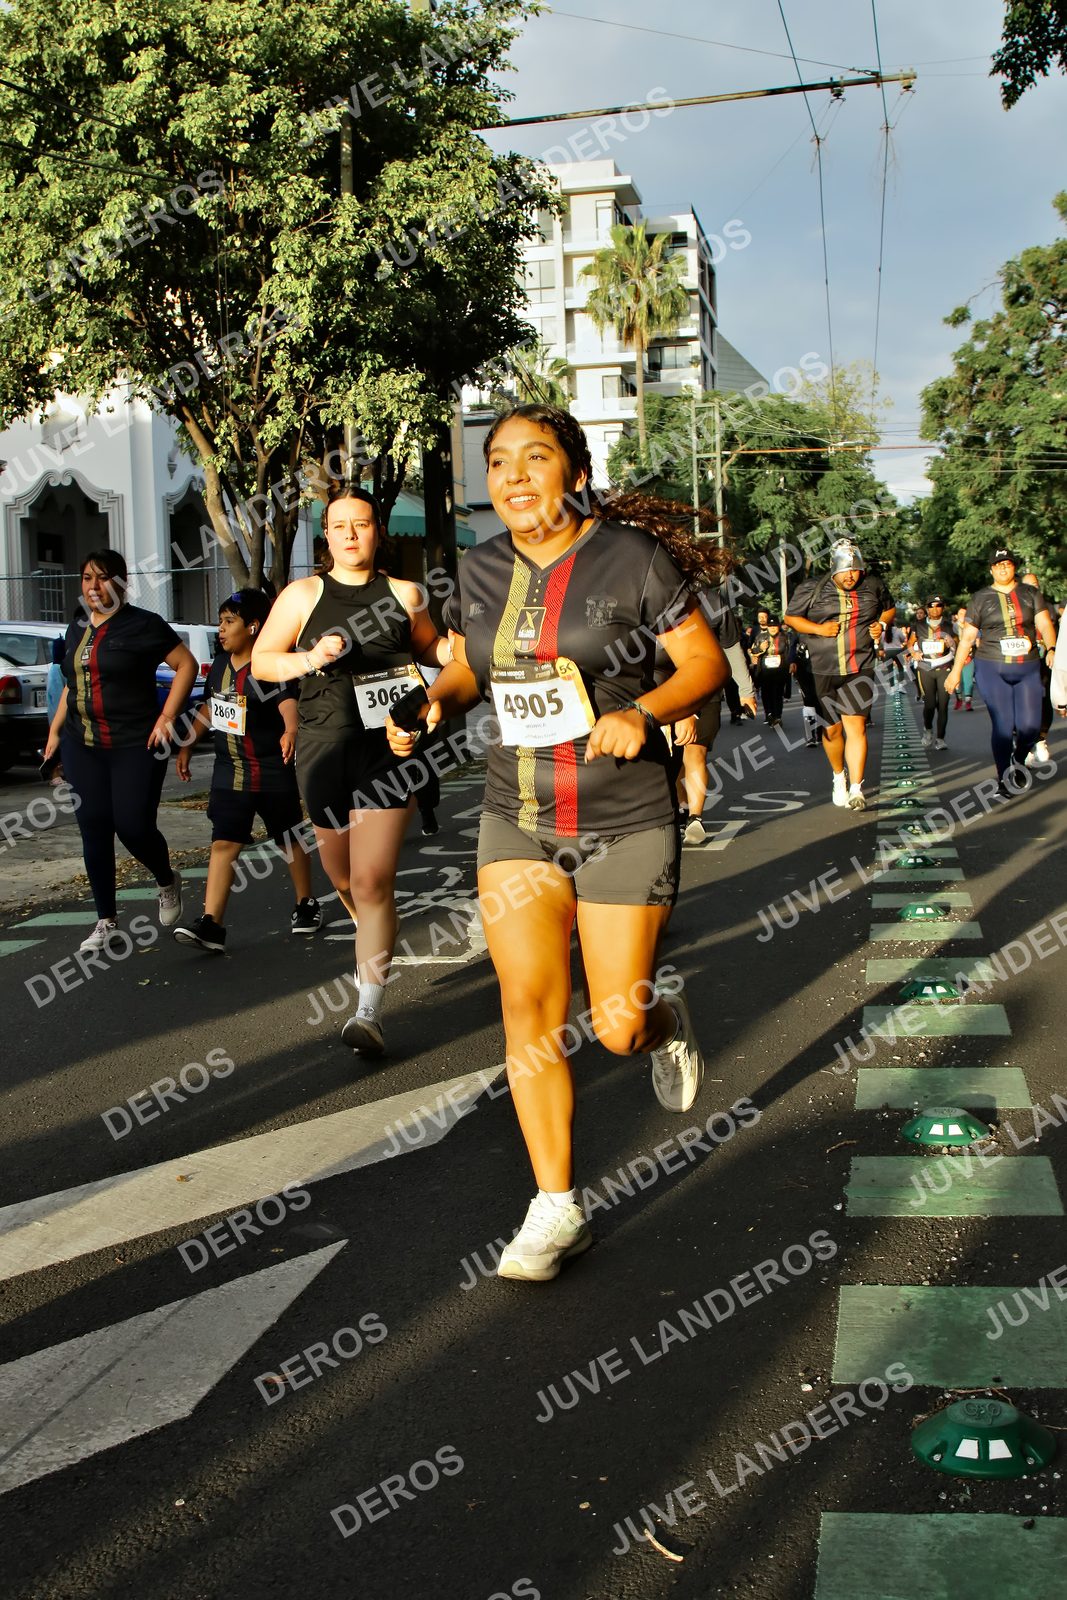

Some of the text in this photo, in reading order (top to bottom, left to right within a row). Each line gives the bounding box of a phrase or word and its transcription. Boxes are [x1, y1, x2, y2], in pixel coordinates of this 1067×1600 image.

[1006, 641, 1026, 649] 1964
[214, 703, 236, 720] 2869
[503, 687, 564, 719] 4905
